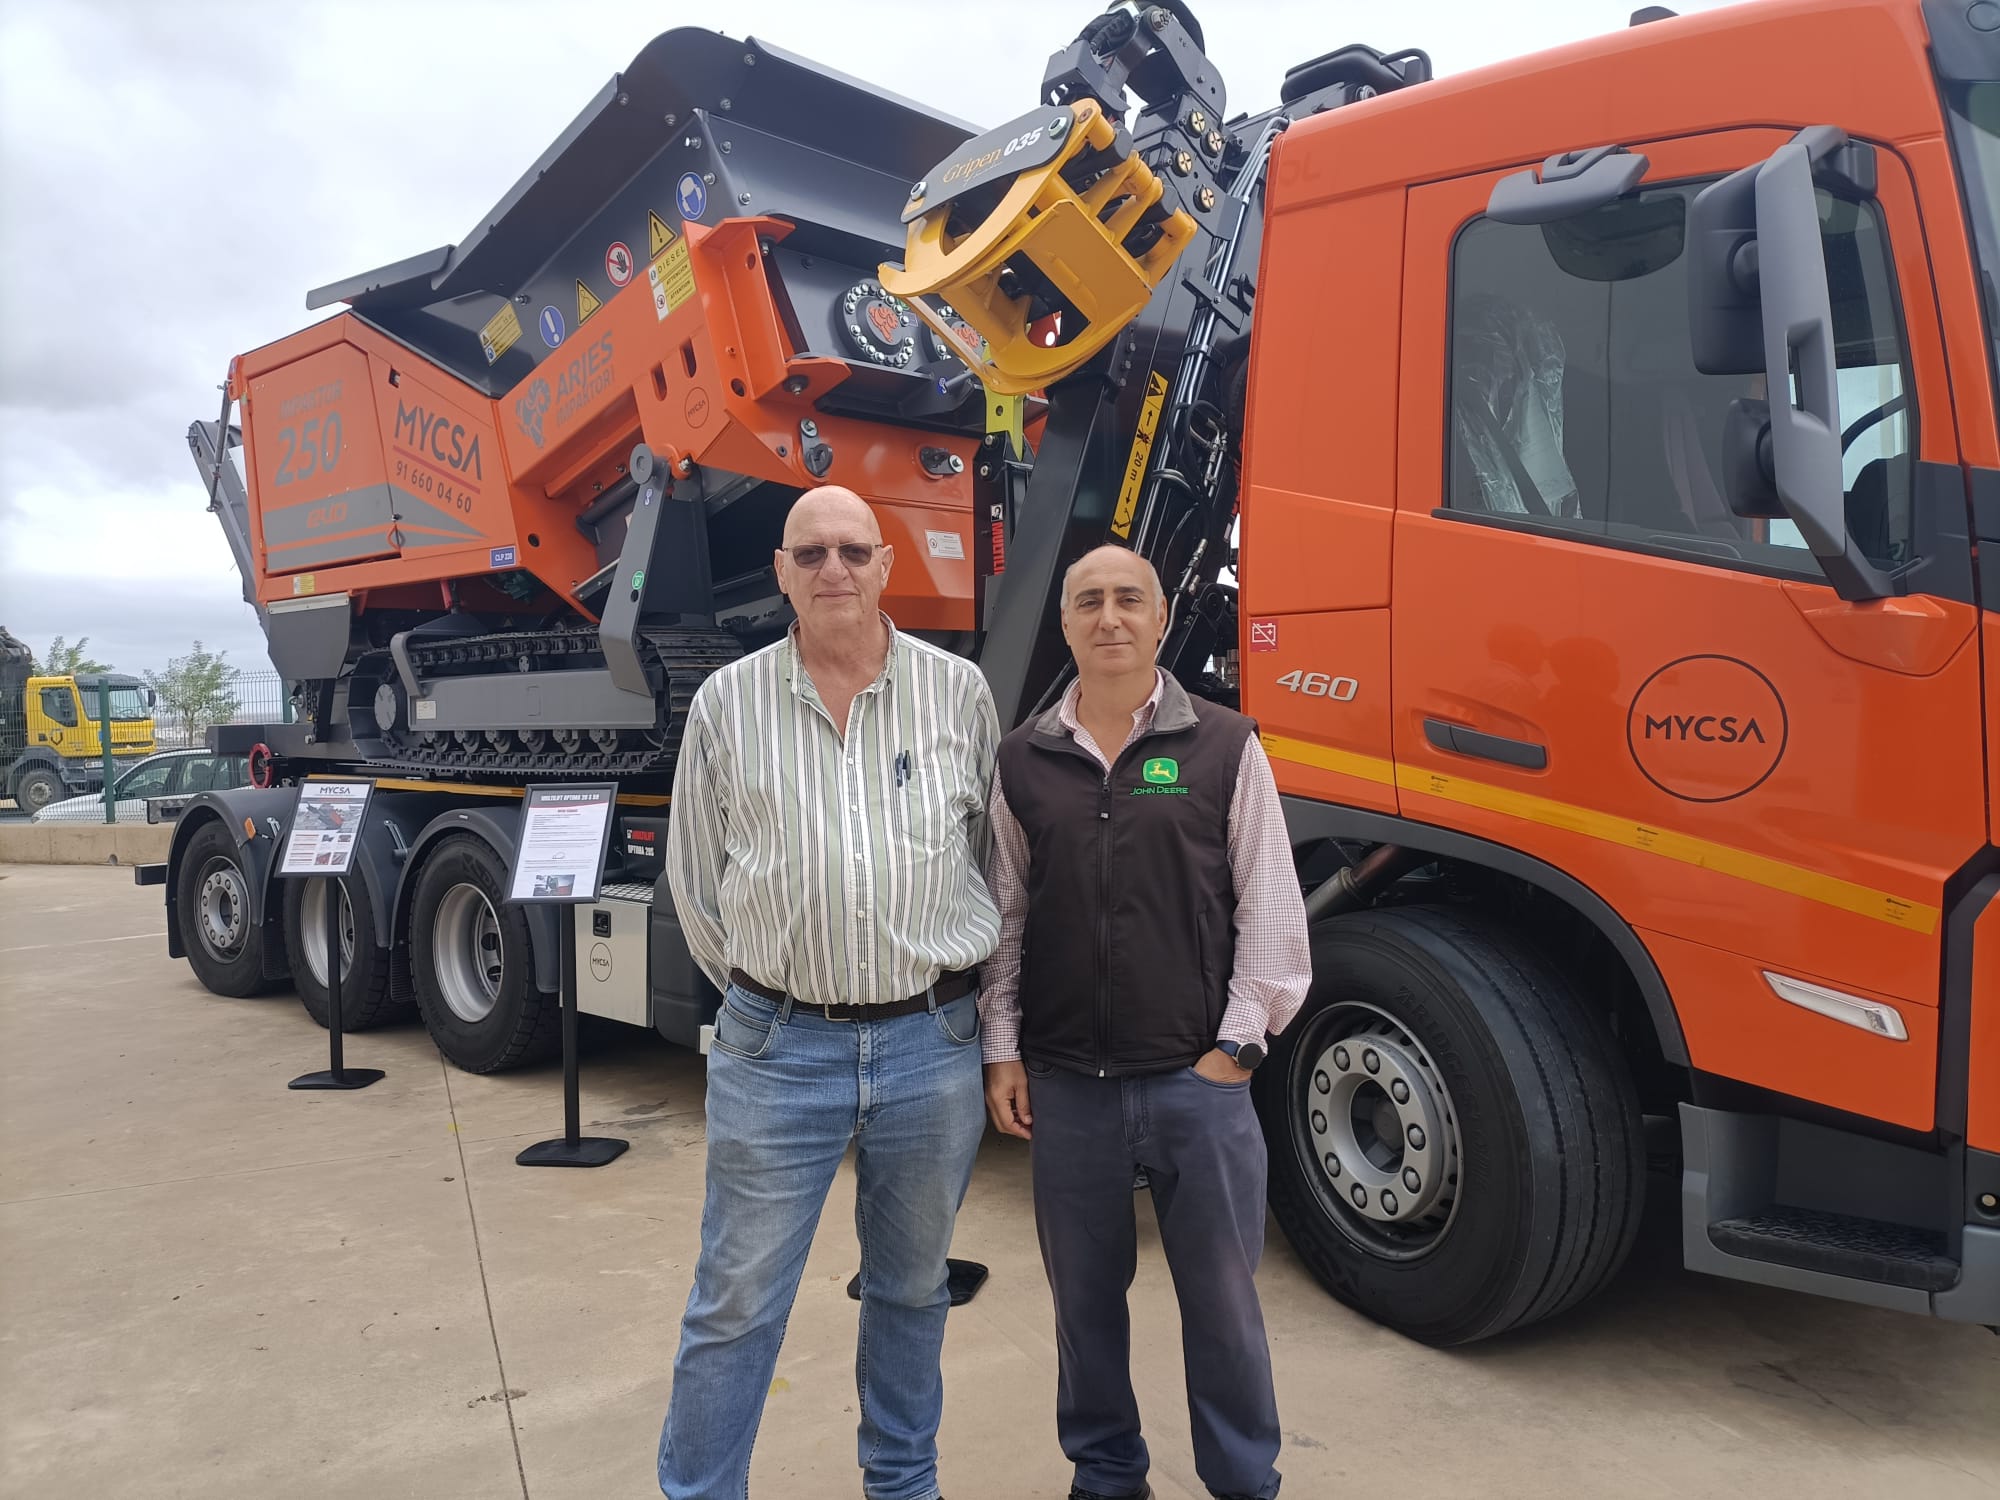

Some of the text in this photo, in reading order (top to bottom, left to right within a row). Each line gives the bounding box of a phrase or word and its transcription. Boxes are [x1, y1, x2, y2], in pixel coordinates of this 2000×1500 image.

[943, 126, 1045, 184] Gripen 035
[657, 244, 686, 275] DIESEL
[556, 329, 614, 405] ARJES
[273, 410, 343, 487] 250
[395, 397, 482, 481] MYCSA
[1134, 451, 1144, 468] 20
[396, 461, 472, 513] 91 660 04 60
[991, 521, 1007, 576] MULTILI
[1276, 669, 1359, 702] 460
[1645, 714, 1766, 744] MYCSA
[319, 787, 351, 795] MYCSA
[1129, 785, 1189, 796] JOHN DEERE
[627, 844, 645, 856] OPTIMA
